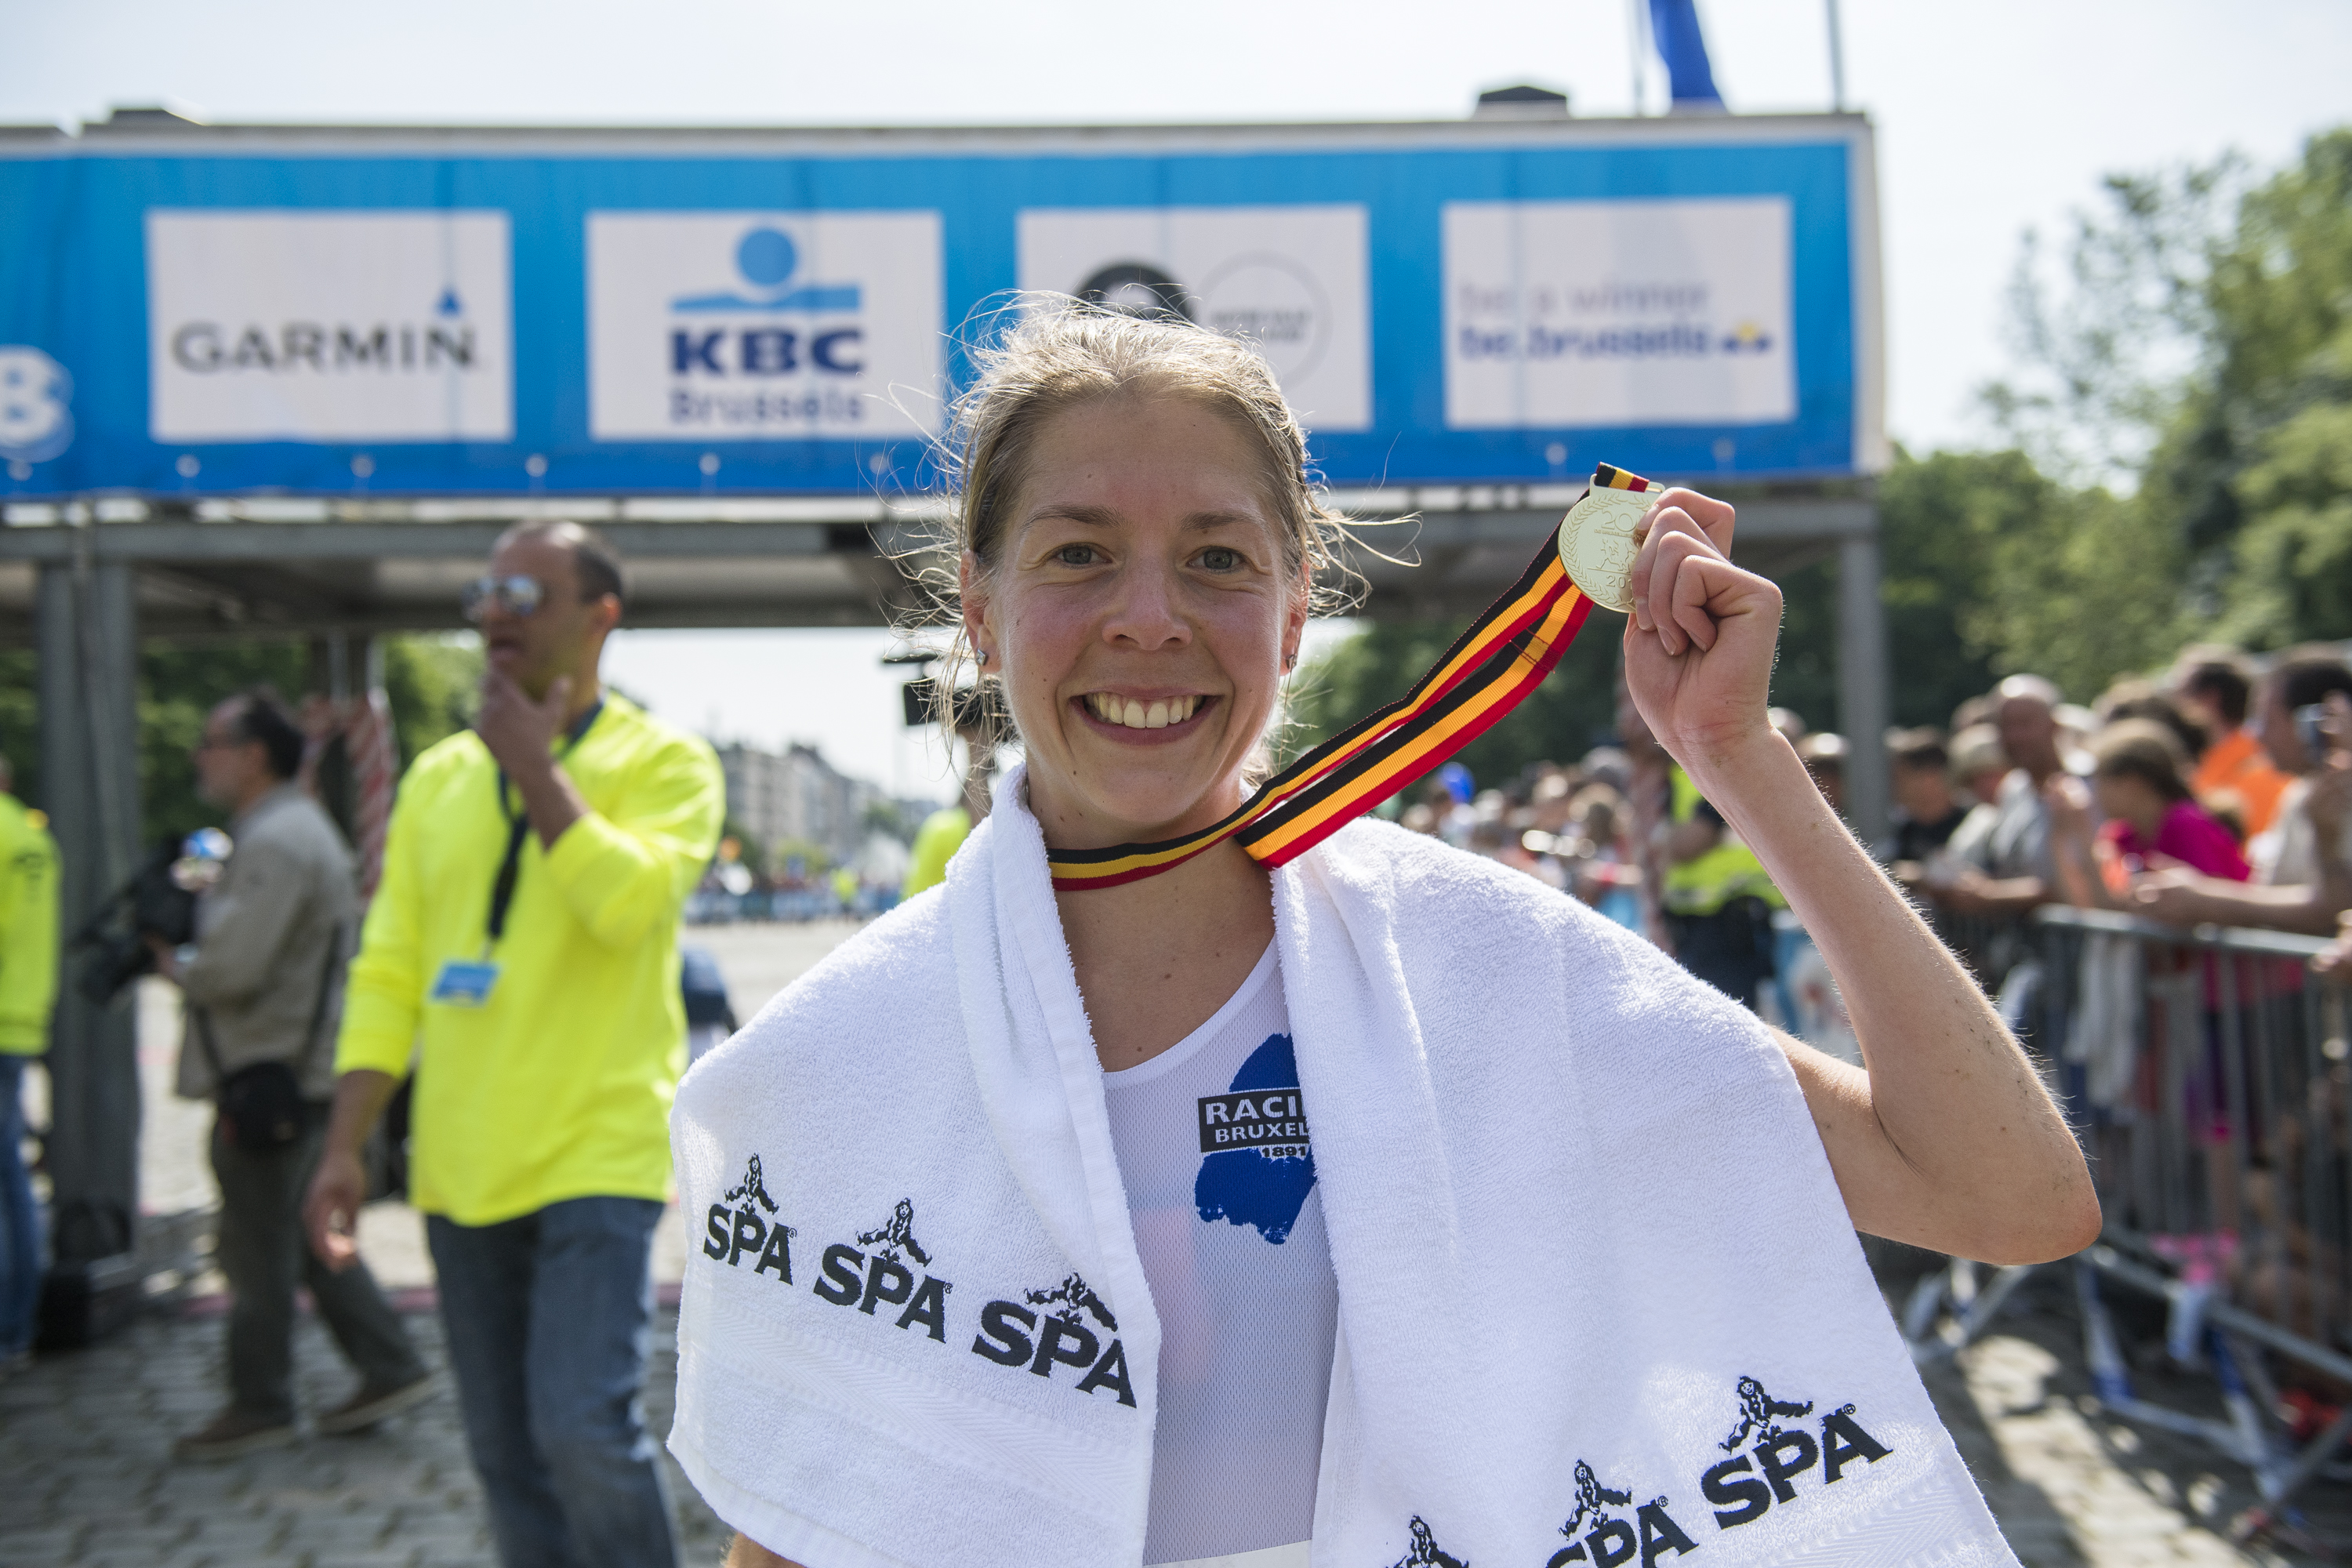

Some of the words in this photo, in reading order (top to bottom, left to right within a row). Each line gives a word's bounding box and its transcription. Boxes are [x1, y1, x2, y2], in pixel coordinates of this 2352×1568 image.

[172, 321, 479, 374] GARMIN
[670, 328, 866, 376] KBC
[670, 389, 866, 423] Brussels
[1206, 1095, 1306, 1125] RACI
[1261, 1146, 1306, 1158] 1891
[703, 1203, 793, 1286] SPA
[814, 1243, 946, 1344] SPA
[972, 1300, 1137, 1408] SPA
[1701, 1409, 1893, 1530] SPA
